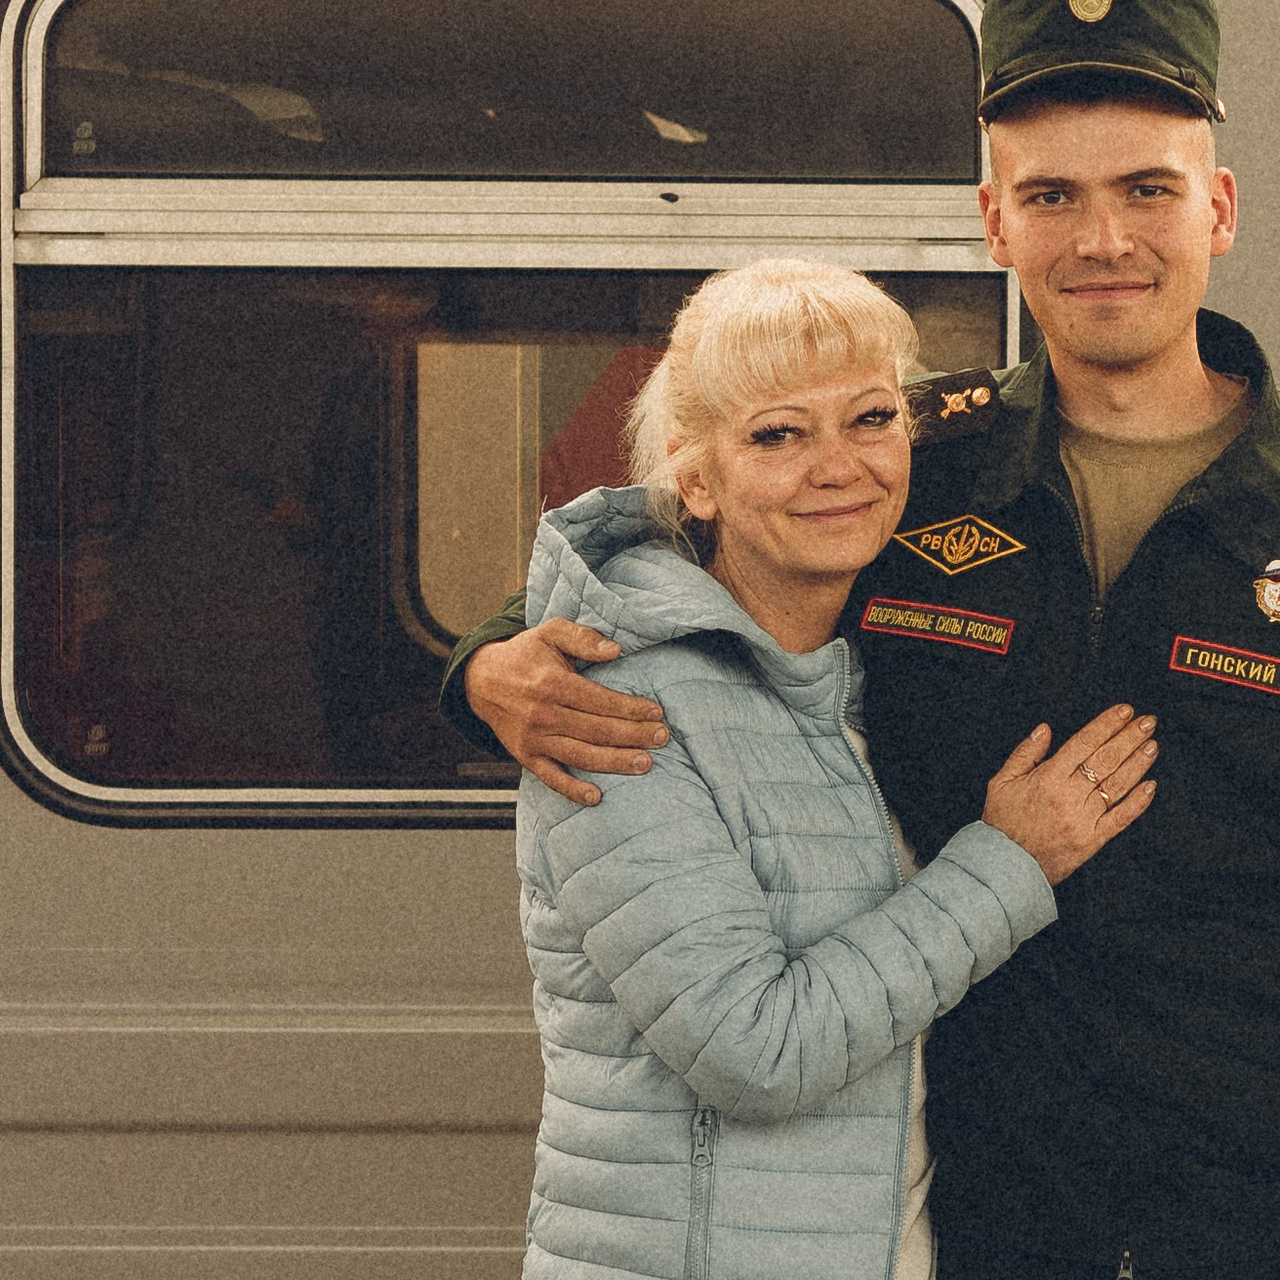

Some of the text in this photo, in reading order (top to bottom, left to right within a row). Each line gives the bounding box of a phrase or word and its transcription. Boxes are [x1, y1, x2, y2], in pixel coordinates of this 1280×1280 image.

[867, 606, 1008, 645] ВООРУЖЕННЫЕ СИЛЫ РОССИИ
[1185, 648, 1276, 684] ГОНСКИЙ
